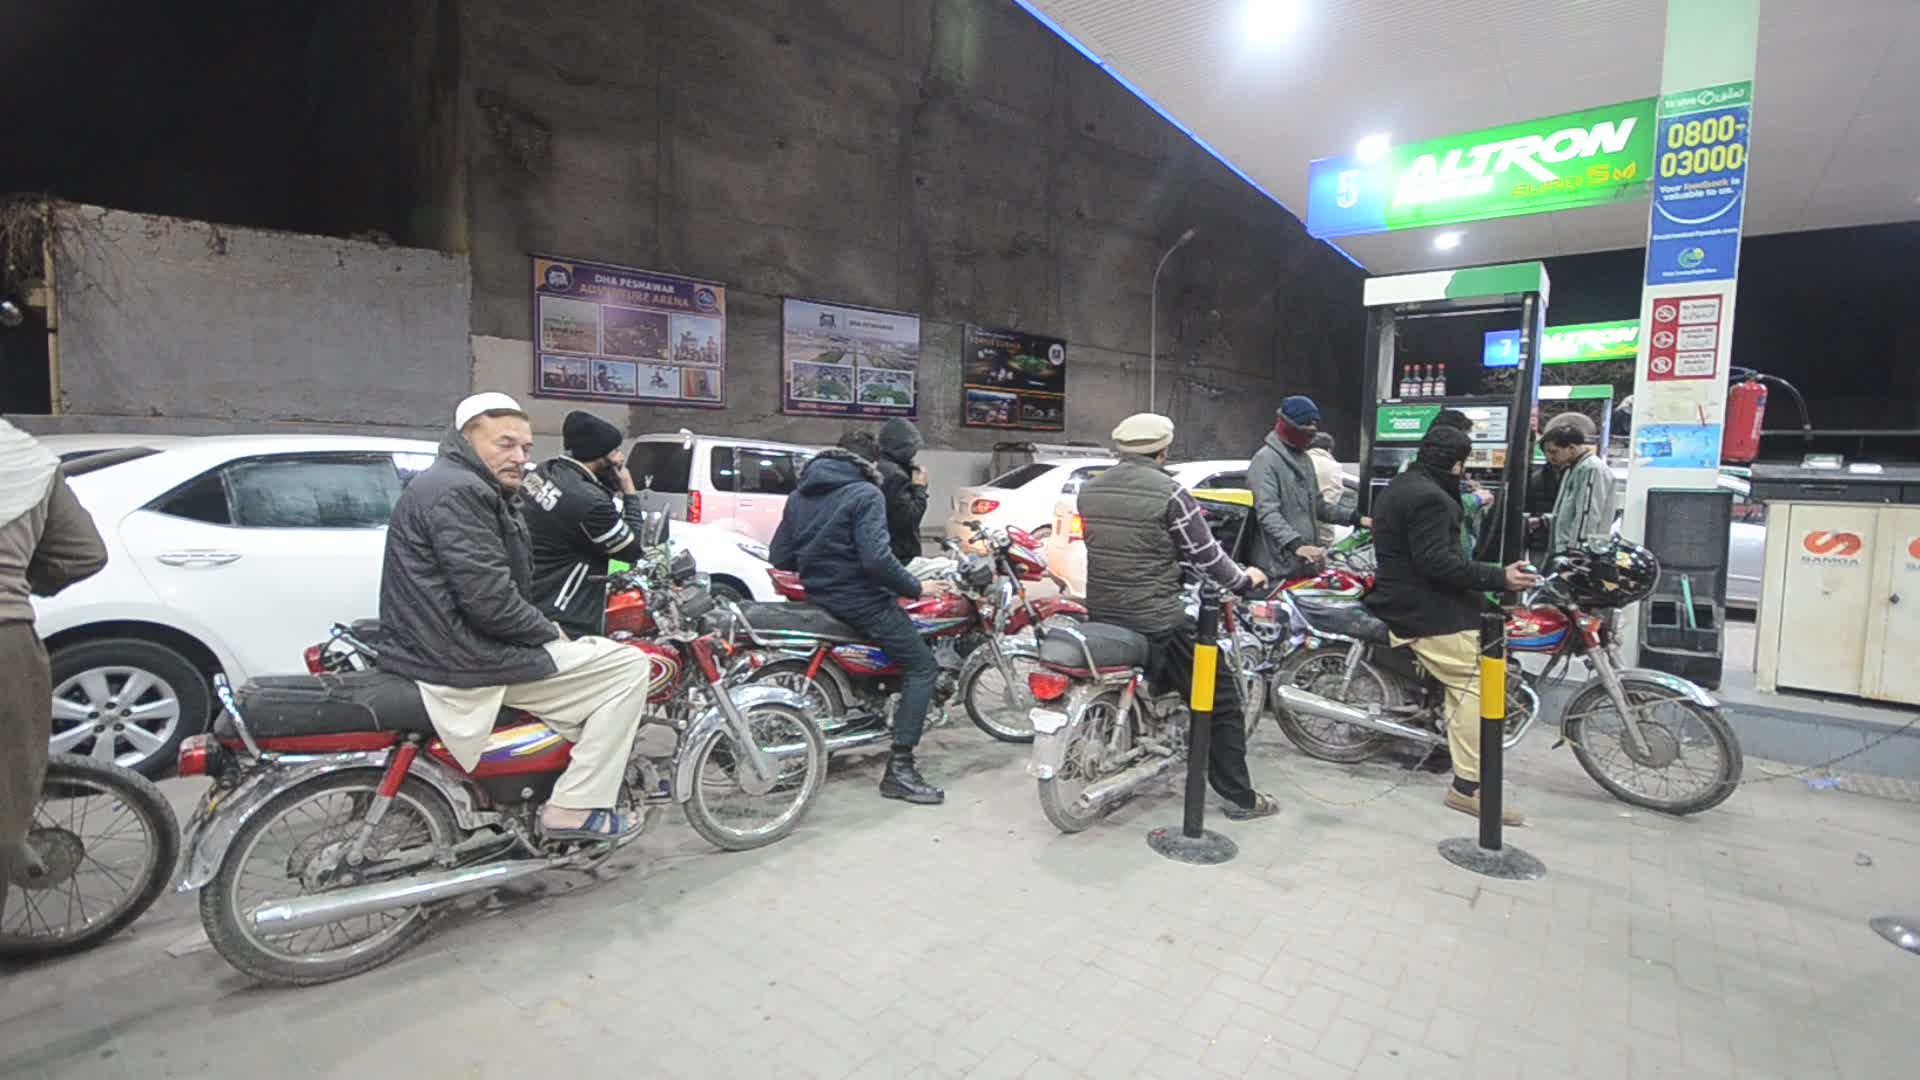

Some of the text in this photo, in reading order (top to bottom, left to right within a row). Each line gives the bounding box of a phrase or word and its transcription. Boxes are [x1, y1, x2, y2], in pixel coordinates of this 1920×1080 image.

[1667, 115, 1746, 149] 0800-
[1402, 117, 1638, 183] ALTRON
[1661, 143, 1744, 178] 03000
[1336, 169, 1361, 209] 5
[1511, 176, 1582, 196] EURO
[1586, 164, 1610, 185] 5
[594, 274, 676, 294] DHA PESHAWAR
[1500, 338, 1512, 356] 7
